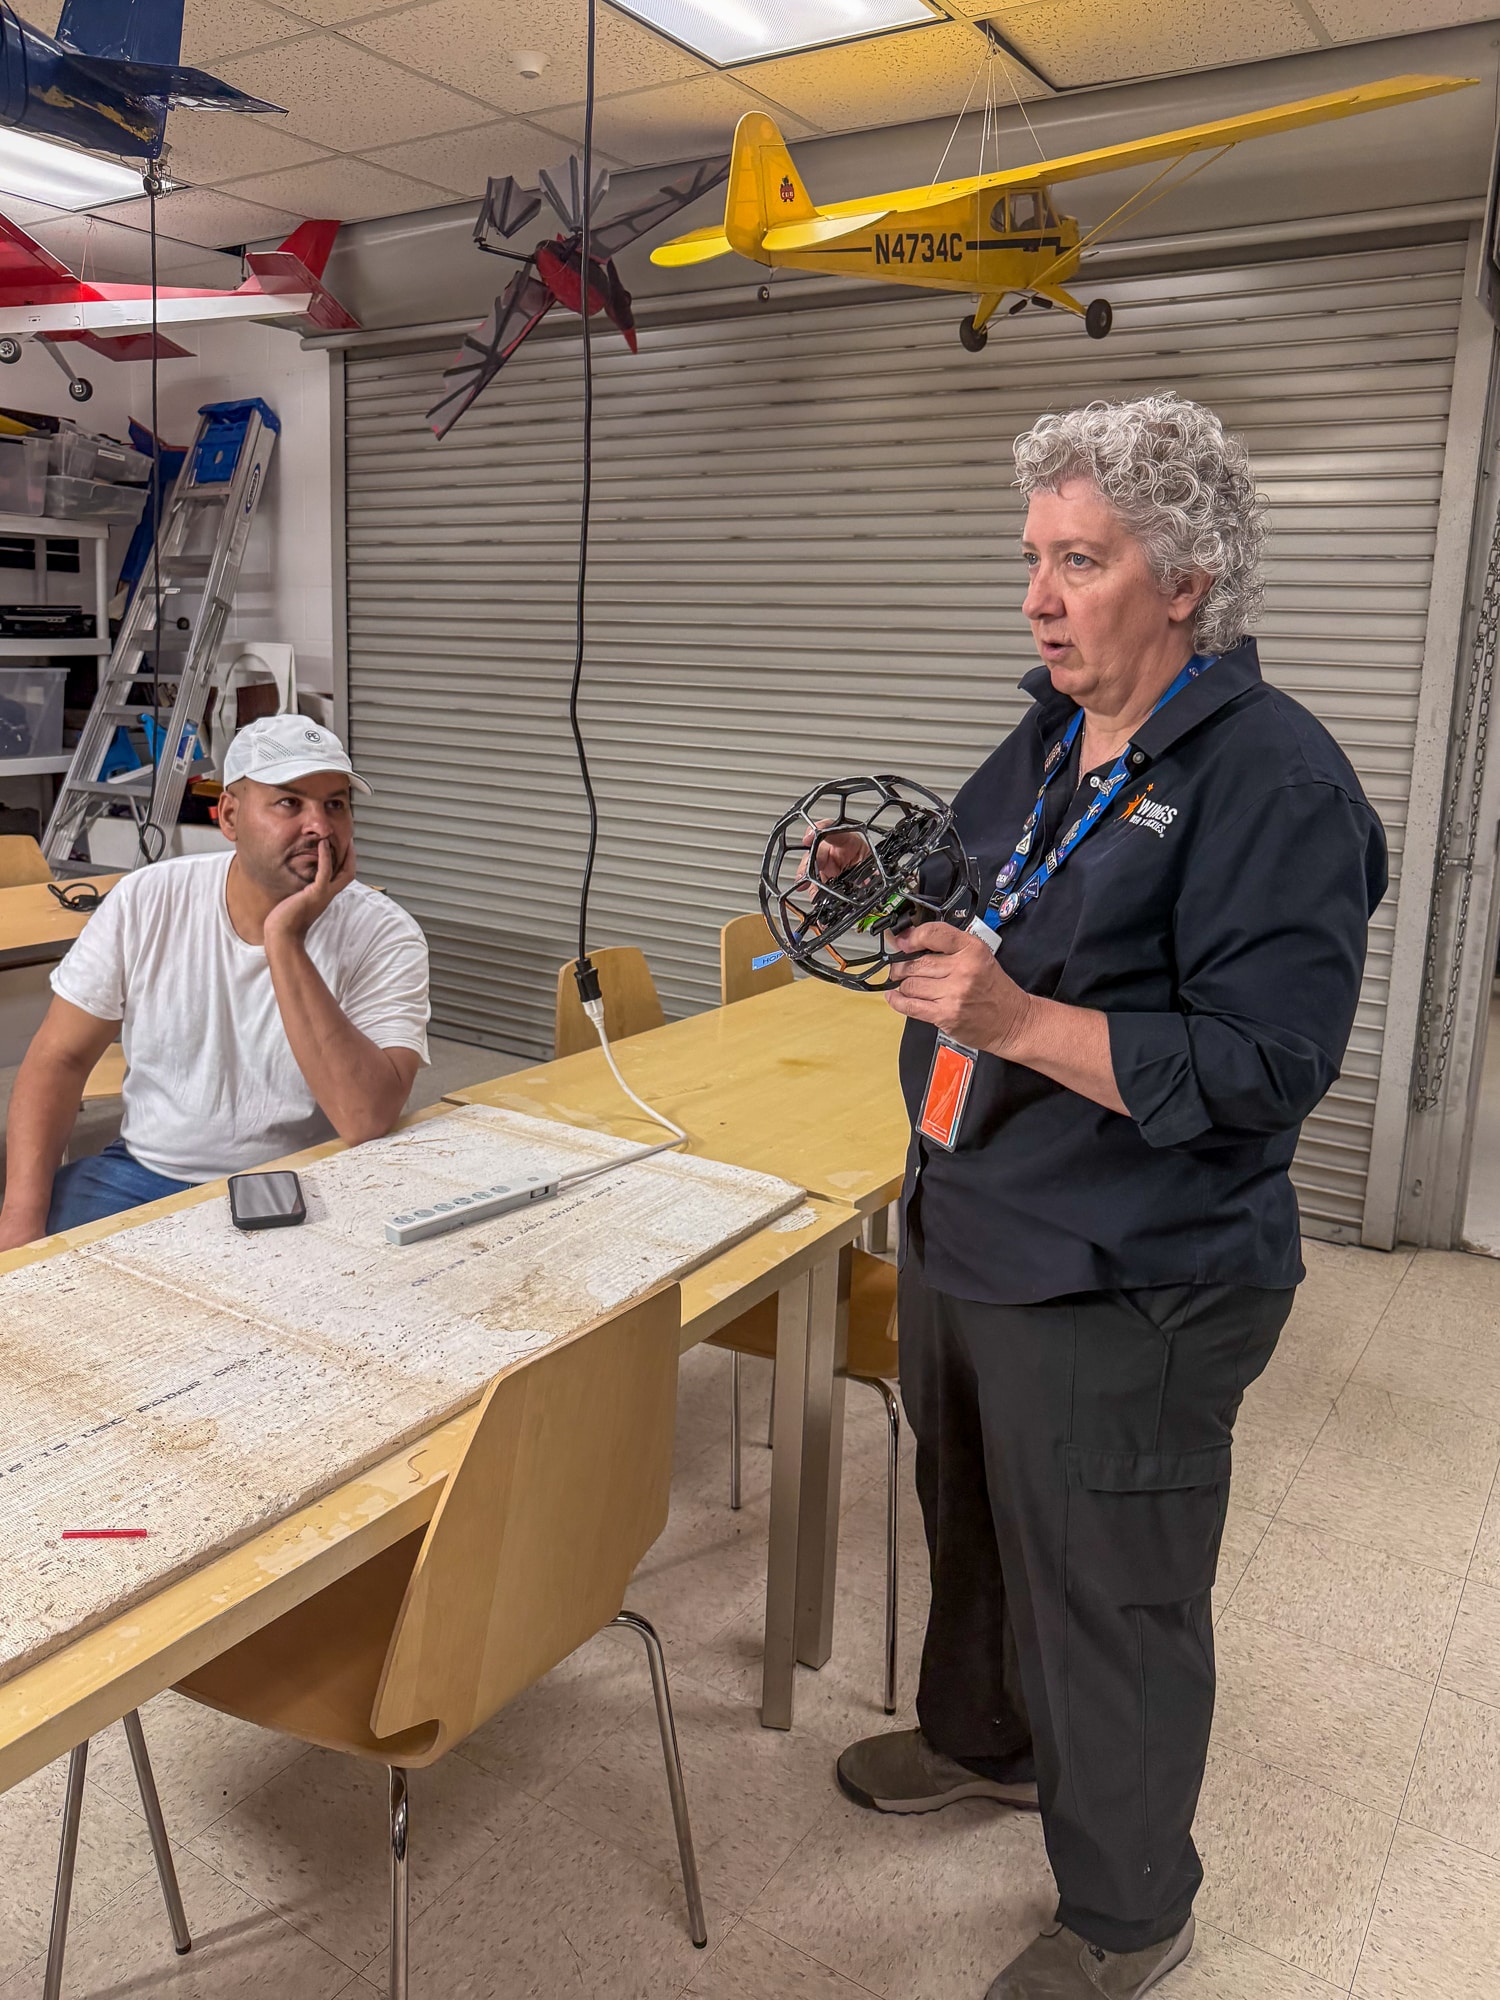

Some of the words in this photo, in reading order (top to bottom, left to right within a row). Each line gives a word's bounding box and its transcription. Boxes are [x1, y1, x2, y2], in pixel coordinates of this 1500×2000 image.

[874, 232, 963, 265] N4734C
[1137, 798, 1178, 824] WINGS
[136, 1380, 203, 1413] RADAR
